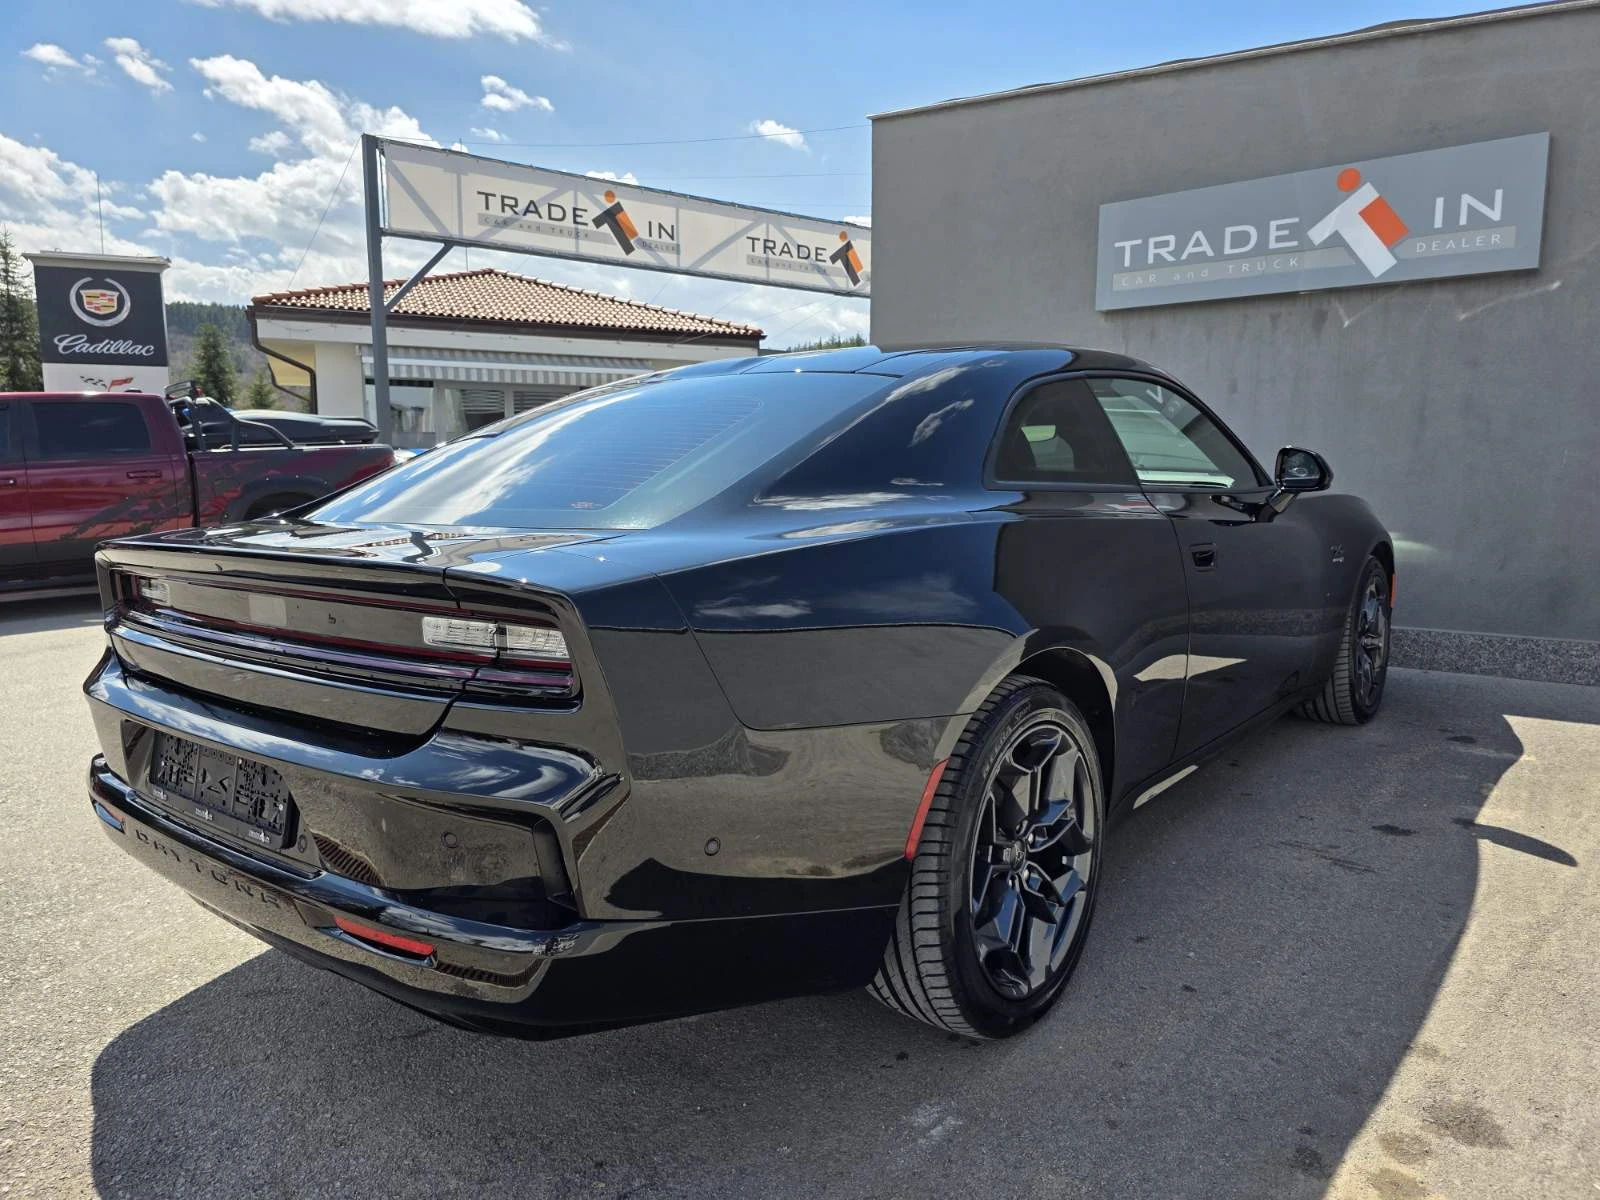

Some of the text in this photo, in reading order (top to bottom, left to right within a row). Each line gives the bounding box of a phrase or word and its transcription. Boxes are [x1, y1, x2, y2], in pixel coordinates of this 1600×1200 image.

[476, 190, 589, 226] TRADE
[648, 220, 676, 242] IN
[1114, 217, 1300, 268] TRADE
[1434, 189, 1504, 229] IN
[746, 236, 827, 263] TRADE
[1120, 232, 1502, 288] CAR and TRUCK DEALER
[53, 333, 155, 357] Cadillac
